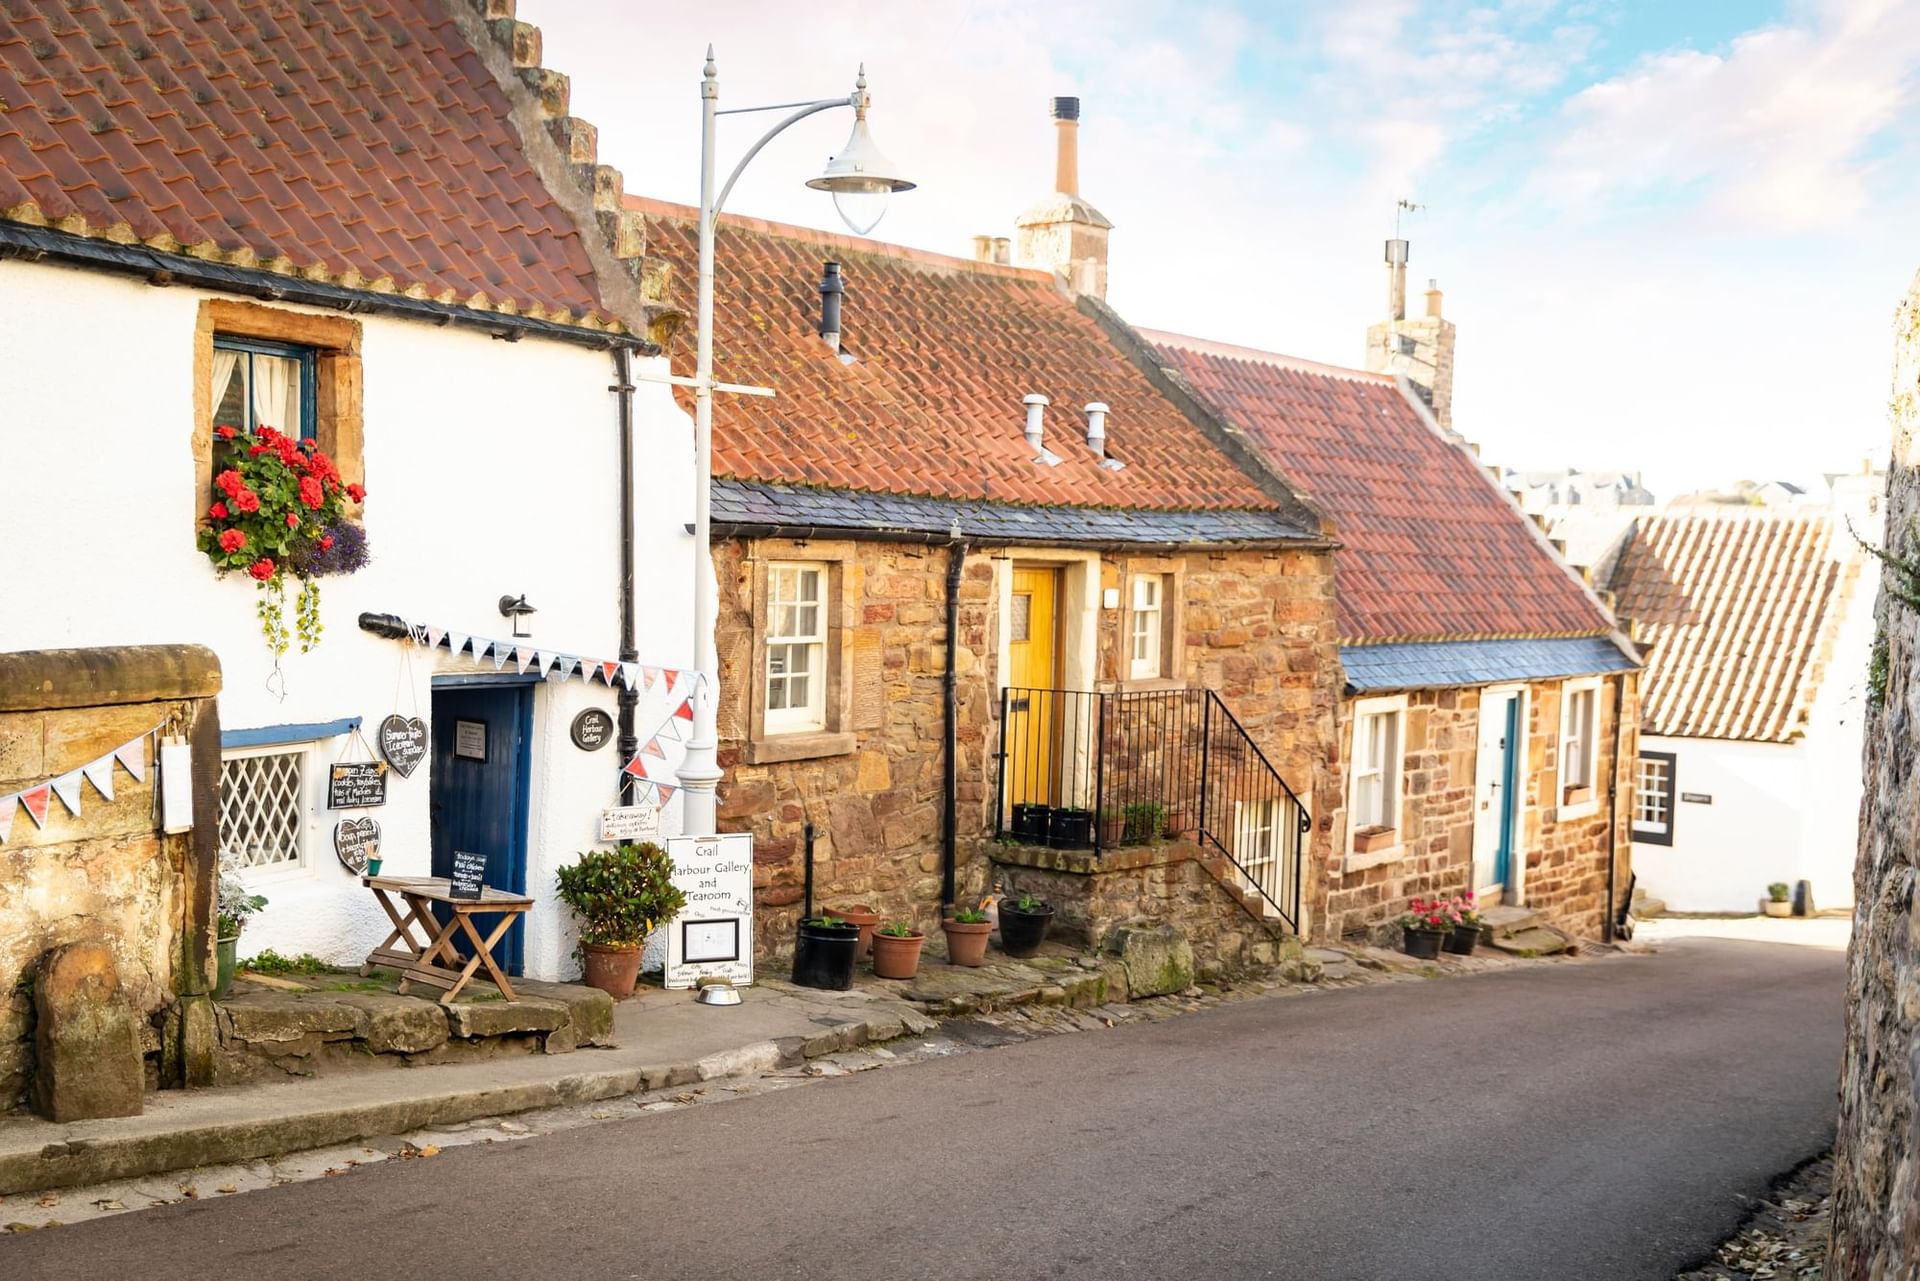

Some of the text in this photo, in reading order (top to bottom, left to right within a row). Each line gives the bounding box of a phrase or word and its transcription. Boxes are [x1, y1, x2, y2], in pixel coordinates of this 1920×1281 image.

[585, 714, 600, 725] Crail
[582, 724, 604, 735] Harbour
[582, 733, 602, 745] Gallery
[695, 844, 718, 857] Crail
[714, 860, 750, 874] Gallery
[698, 877, 717, 888] and
[686, 891, 731, 901] Tearoom
